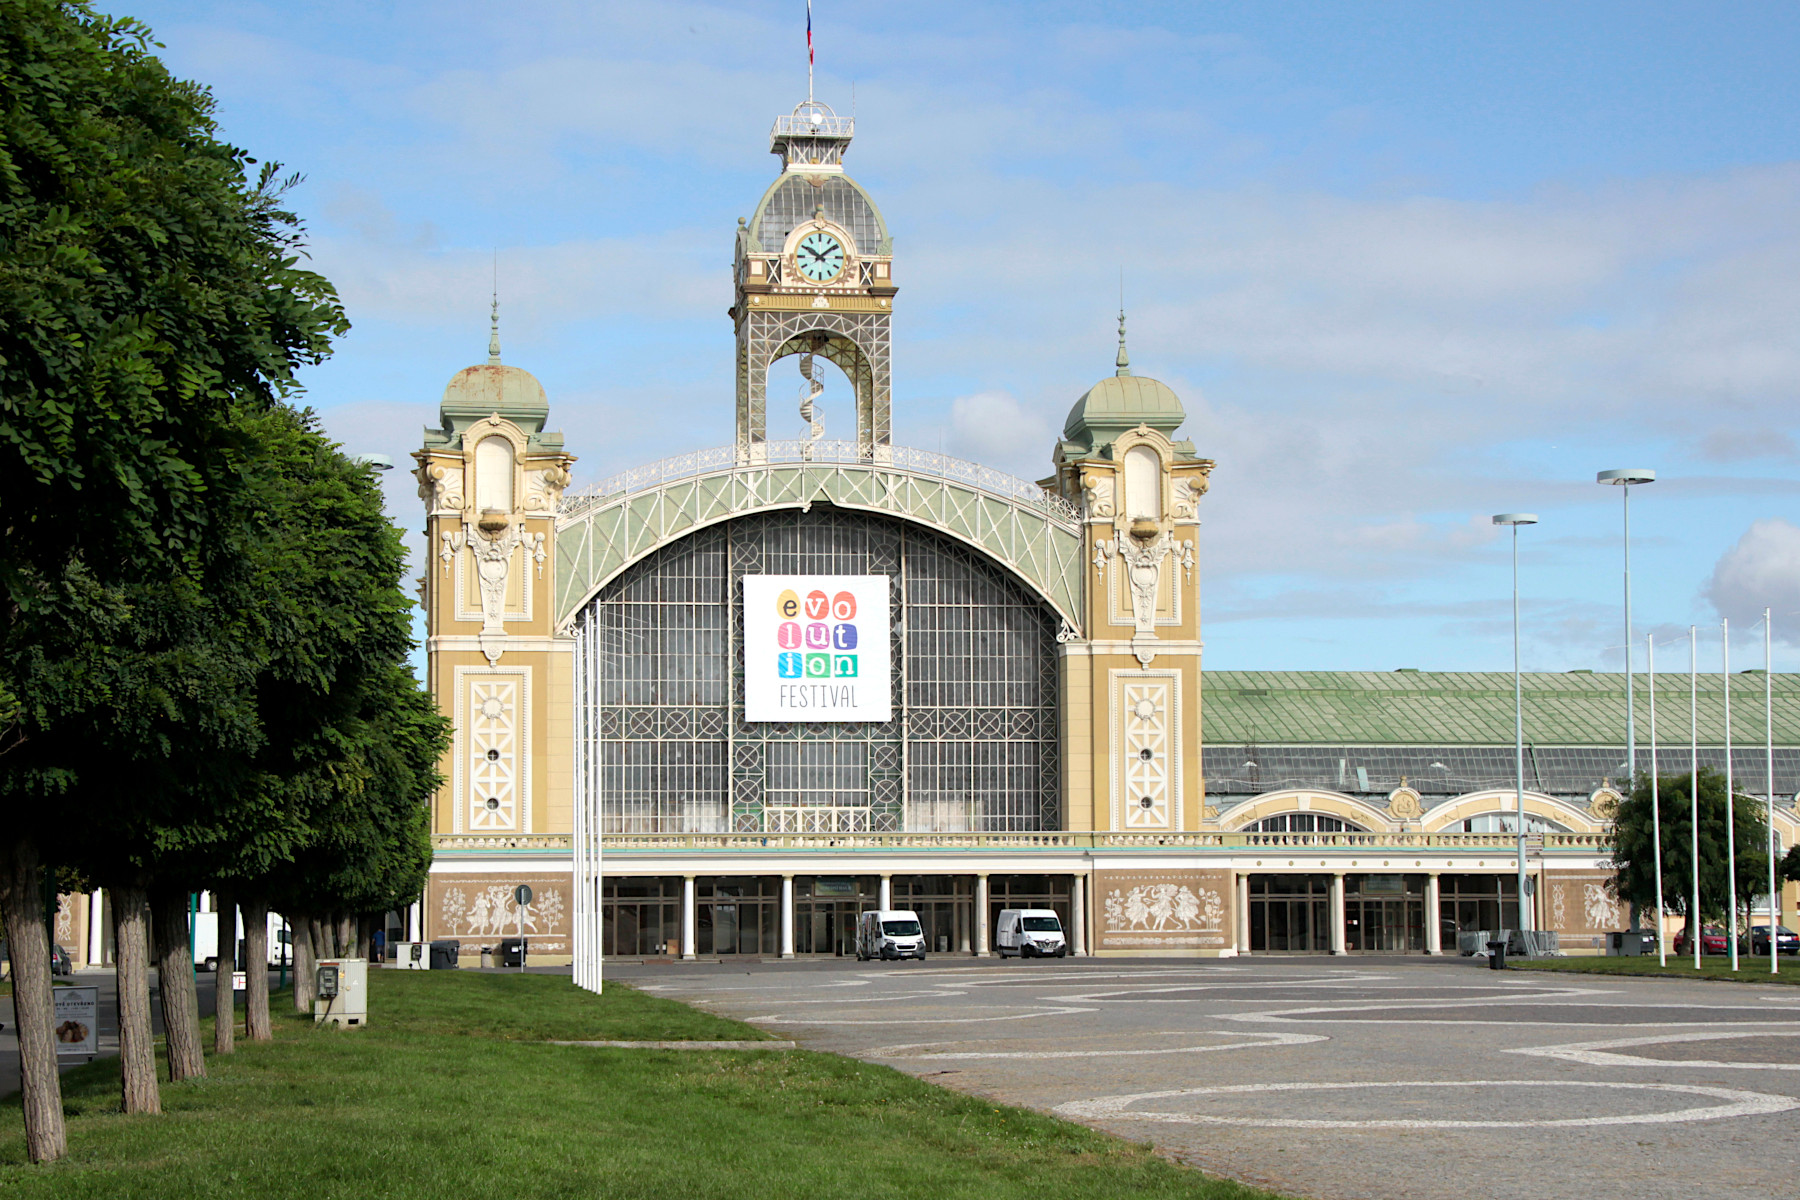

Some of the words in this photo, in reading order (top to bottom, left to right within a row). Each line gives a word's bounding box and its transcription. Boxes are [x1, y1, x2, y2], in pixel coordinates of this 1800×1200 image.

[782, 598, 852, 619] evo
[786, 624, 849, 648] lut
[785, 653, 855, 676] ion
[780, 684, 858, 708] FESTIVAL
